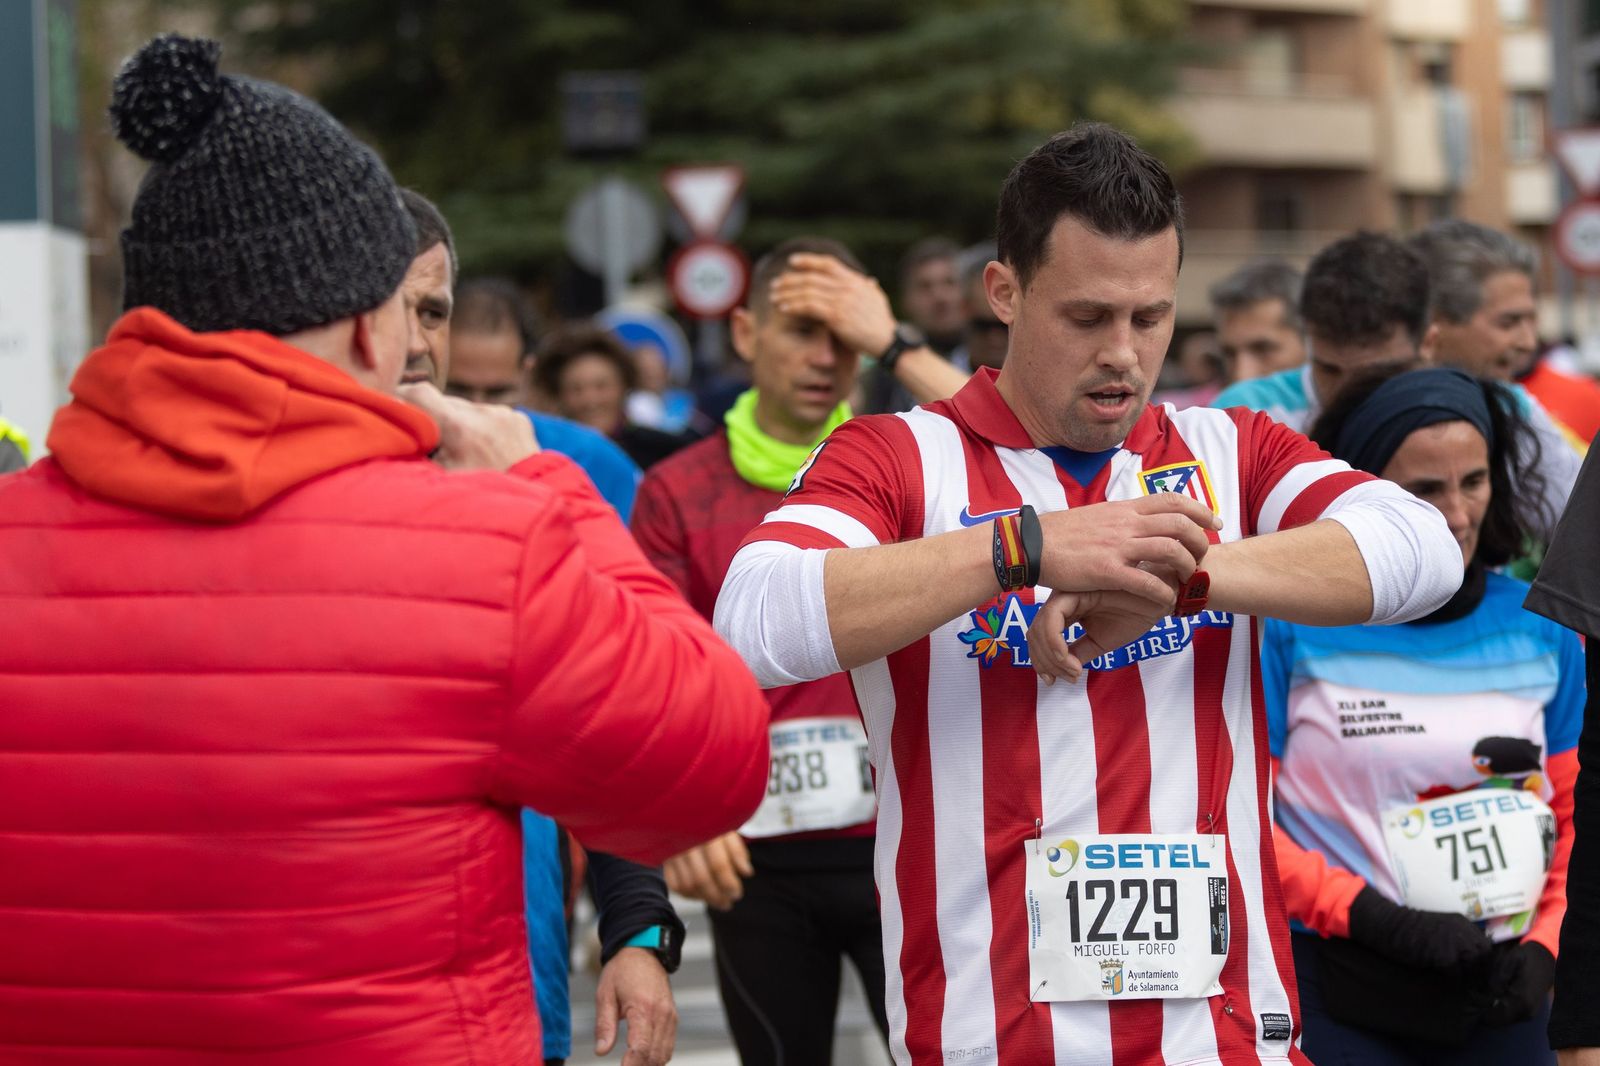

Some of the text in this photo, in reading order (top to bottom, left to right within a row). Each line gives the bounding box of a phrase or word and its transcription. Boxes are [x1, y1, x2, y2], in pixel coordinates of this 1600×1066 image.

[1090, 632, 1182, 669] OF FIRE
[1360, 700, 1386, 709] SAN
[1339, 713, 1402, 725] SILVESTRE
[1341, 724, 1427, 738] SALMANTINA
[1429, 795, 1534, 828] SETEL
[1085, 843, 1210, 869] SETEL
[1434, 824, 1508, 881] 751
[1065, 878, 1179, 943] 1229
[1074, 942, 1176, 957] MIGUEL FORFO
[1128, 969, 1179, 981] Ayuntamiento
[1128, 982, 1179, 992] de Salamanca
